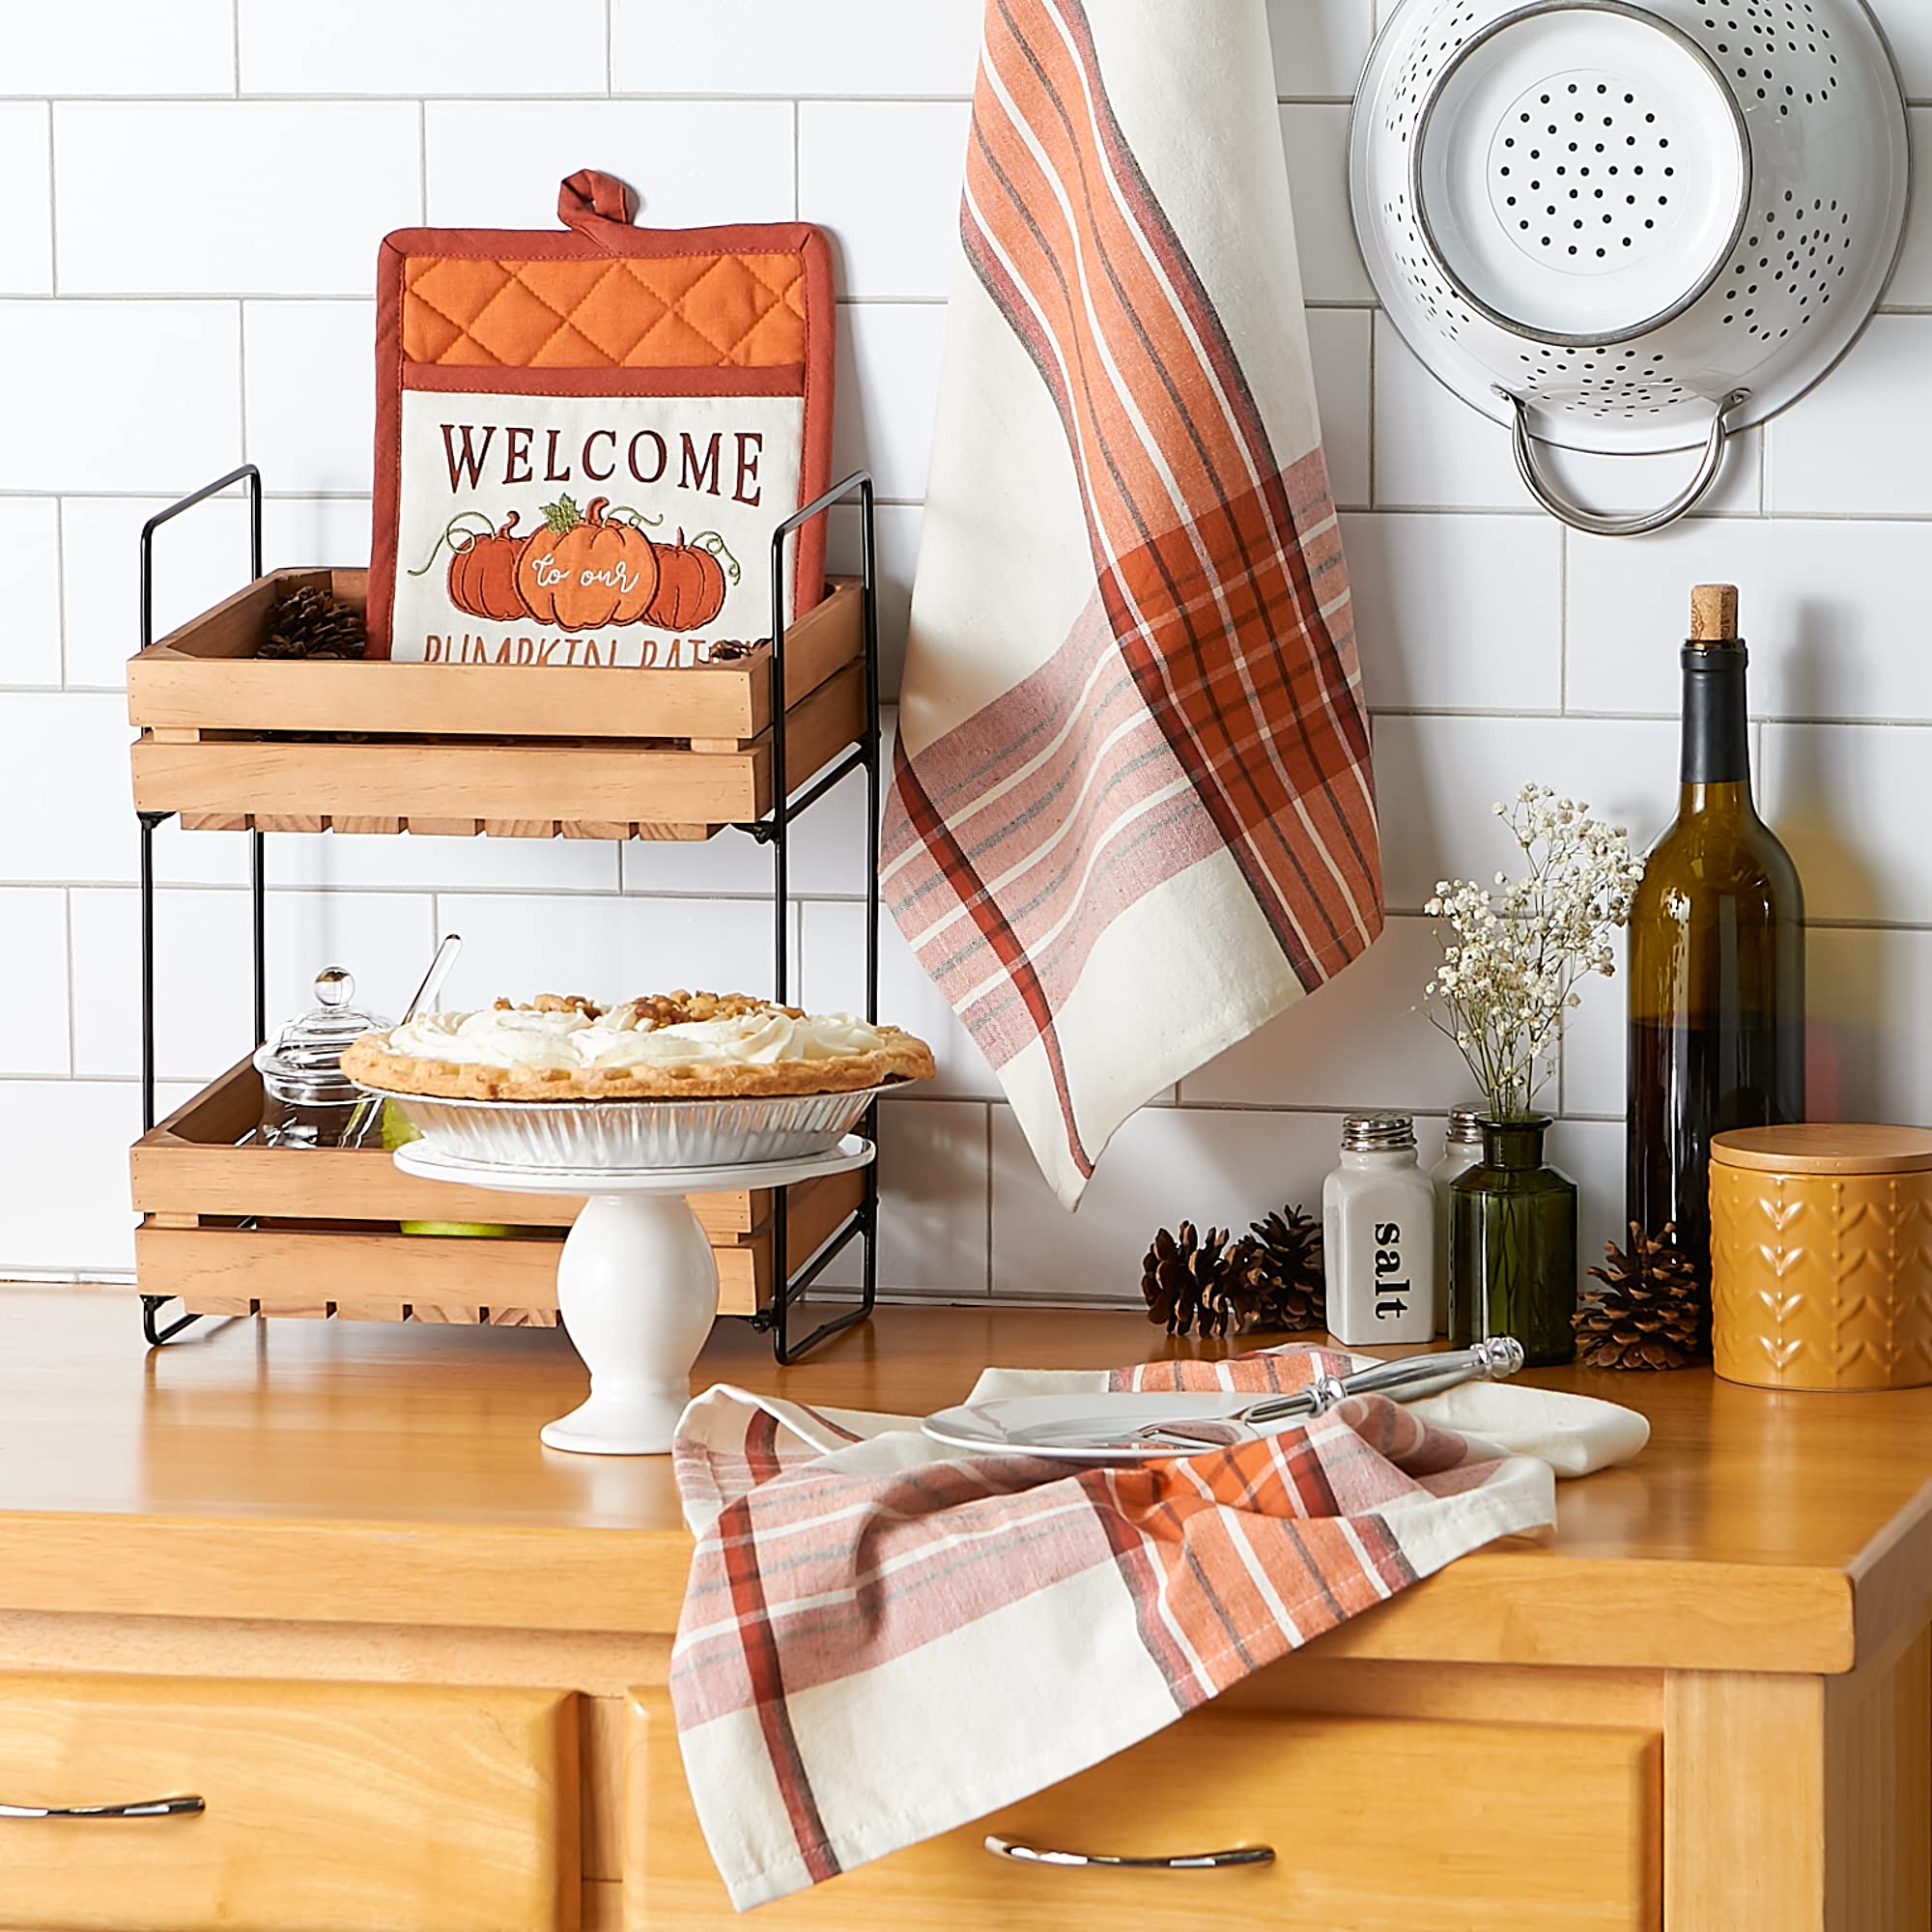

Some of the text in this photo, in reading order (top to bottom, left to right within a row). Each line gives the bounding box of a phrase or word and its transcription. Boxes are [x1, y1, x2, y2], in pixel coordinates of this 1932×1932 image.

[440, 423, 763, 506] WELCOME
[531, 554, 639, 593] to our
[1375, 1222, 1410, 1320] salt
